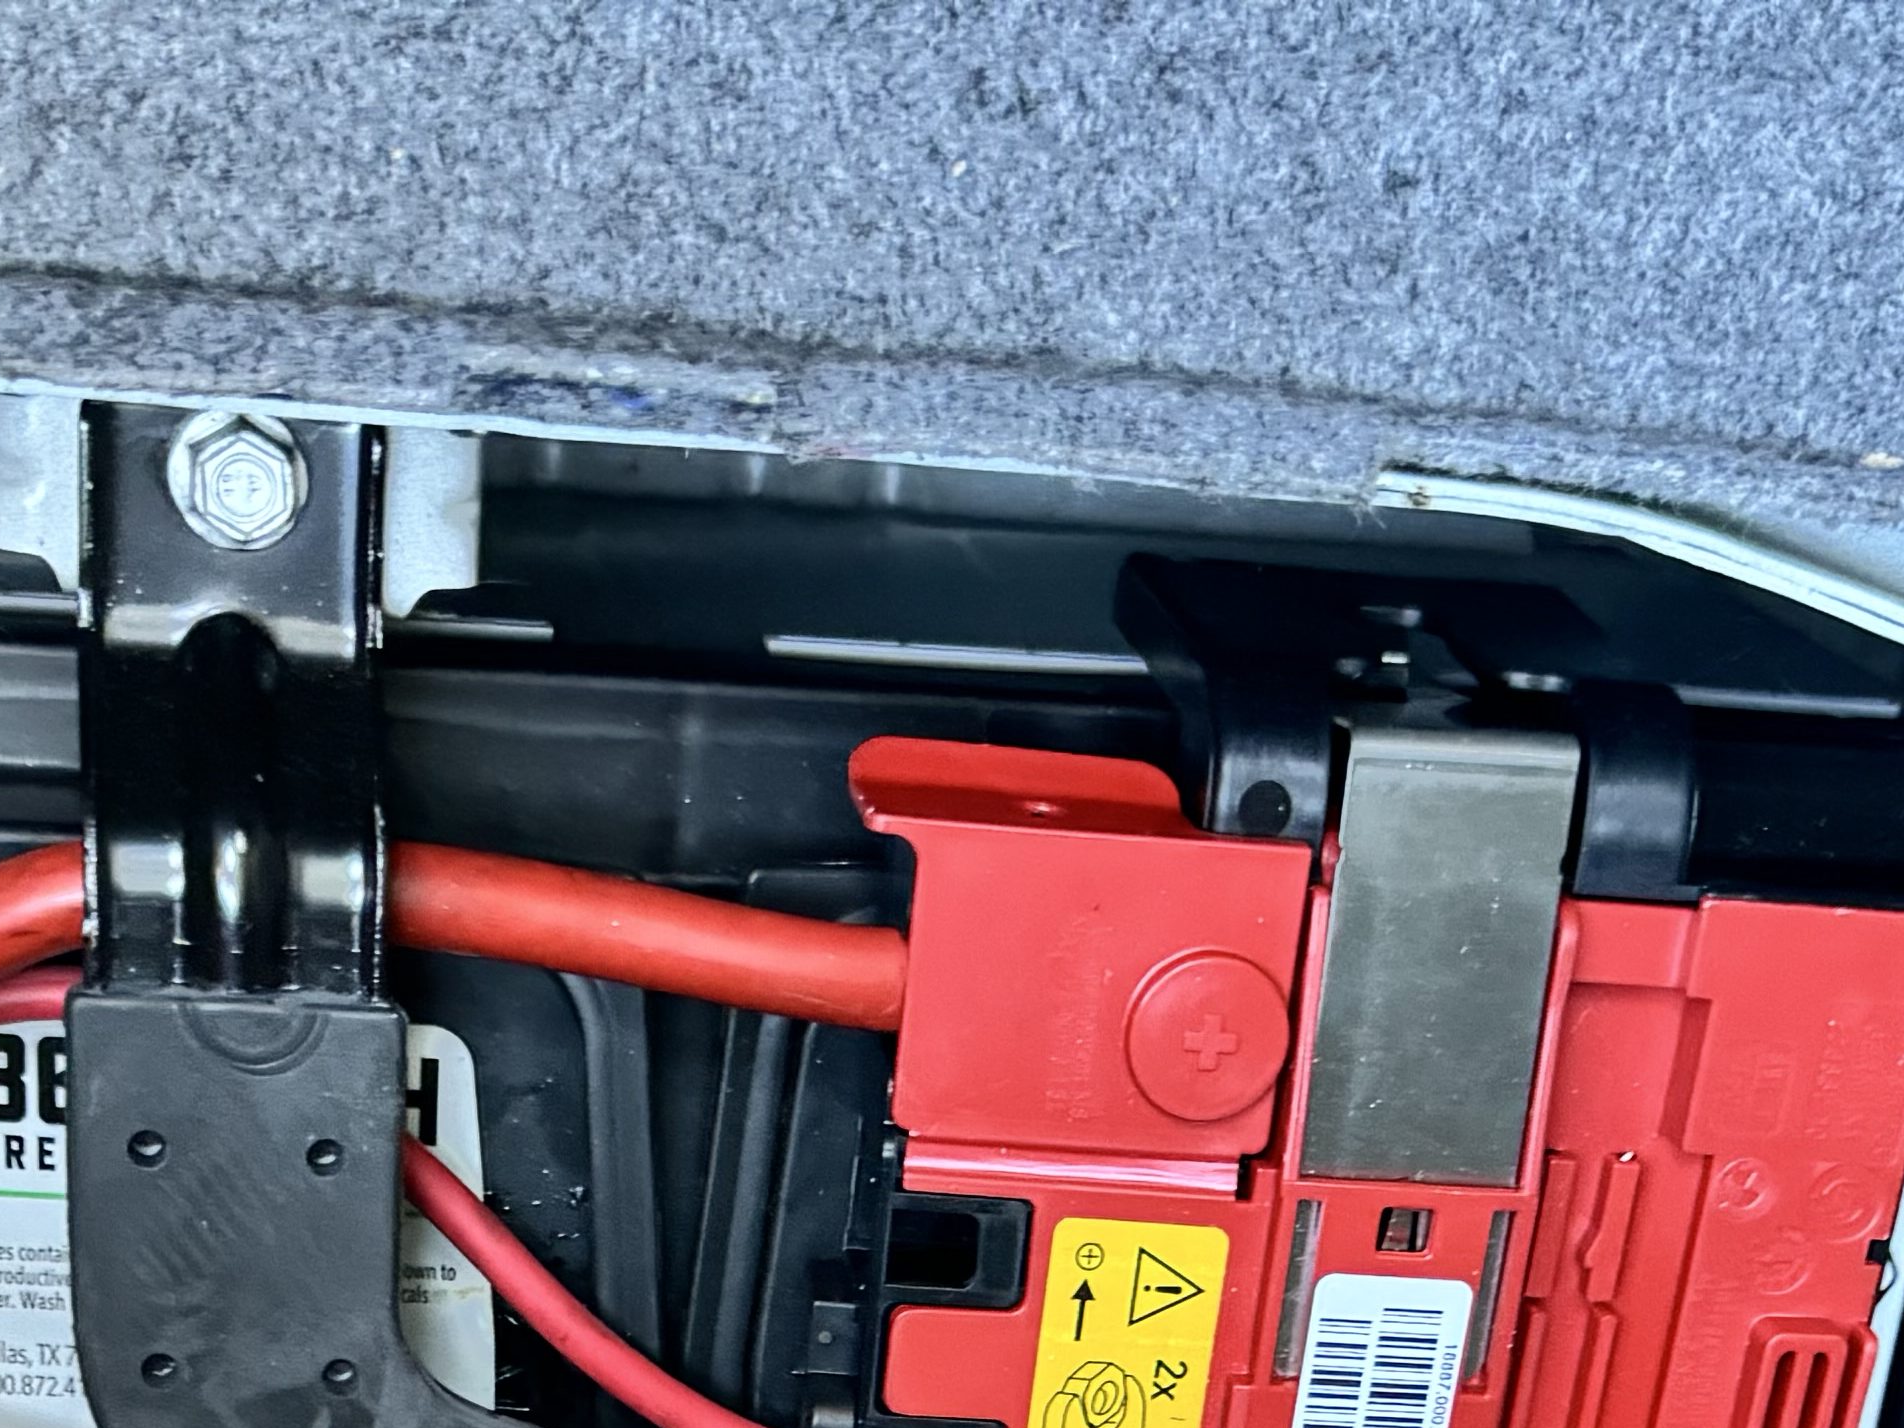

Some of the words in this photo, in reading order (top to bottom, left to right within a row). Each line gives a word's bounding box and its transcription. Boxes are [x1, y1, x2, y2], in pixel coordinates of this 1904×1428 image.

[18, 1245, 69, 1263] contai
[441, 1263, 457, 1281] to
[18, 1290, 66, 1311] Wash
[36, 1343, 61, 1366] TX
[1151, 1358, 1188, 1402] 2x
